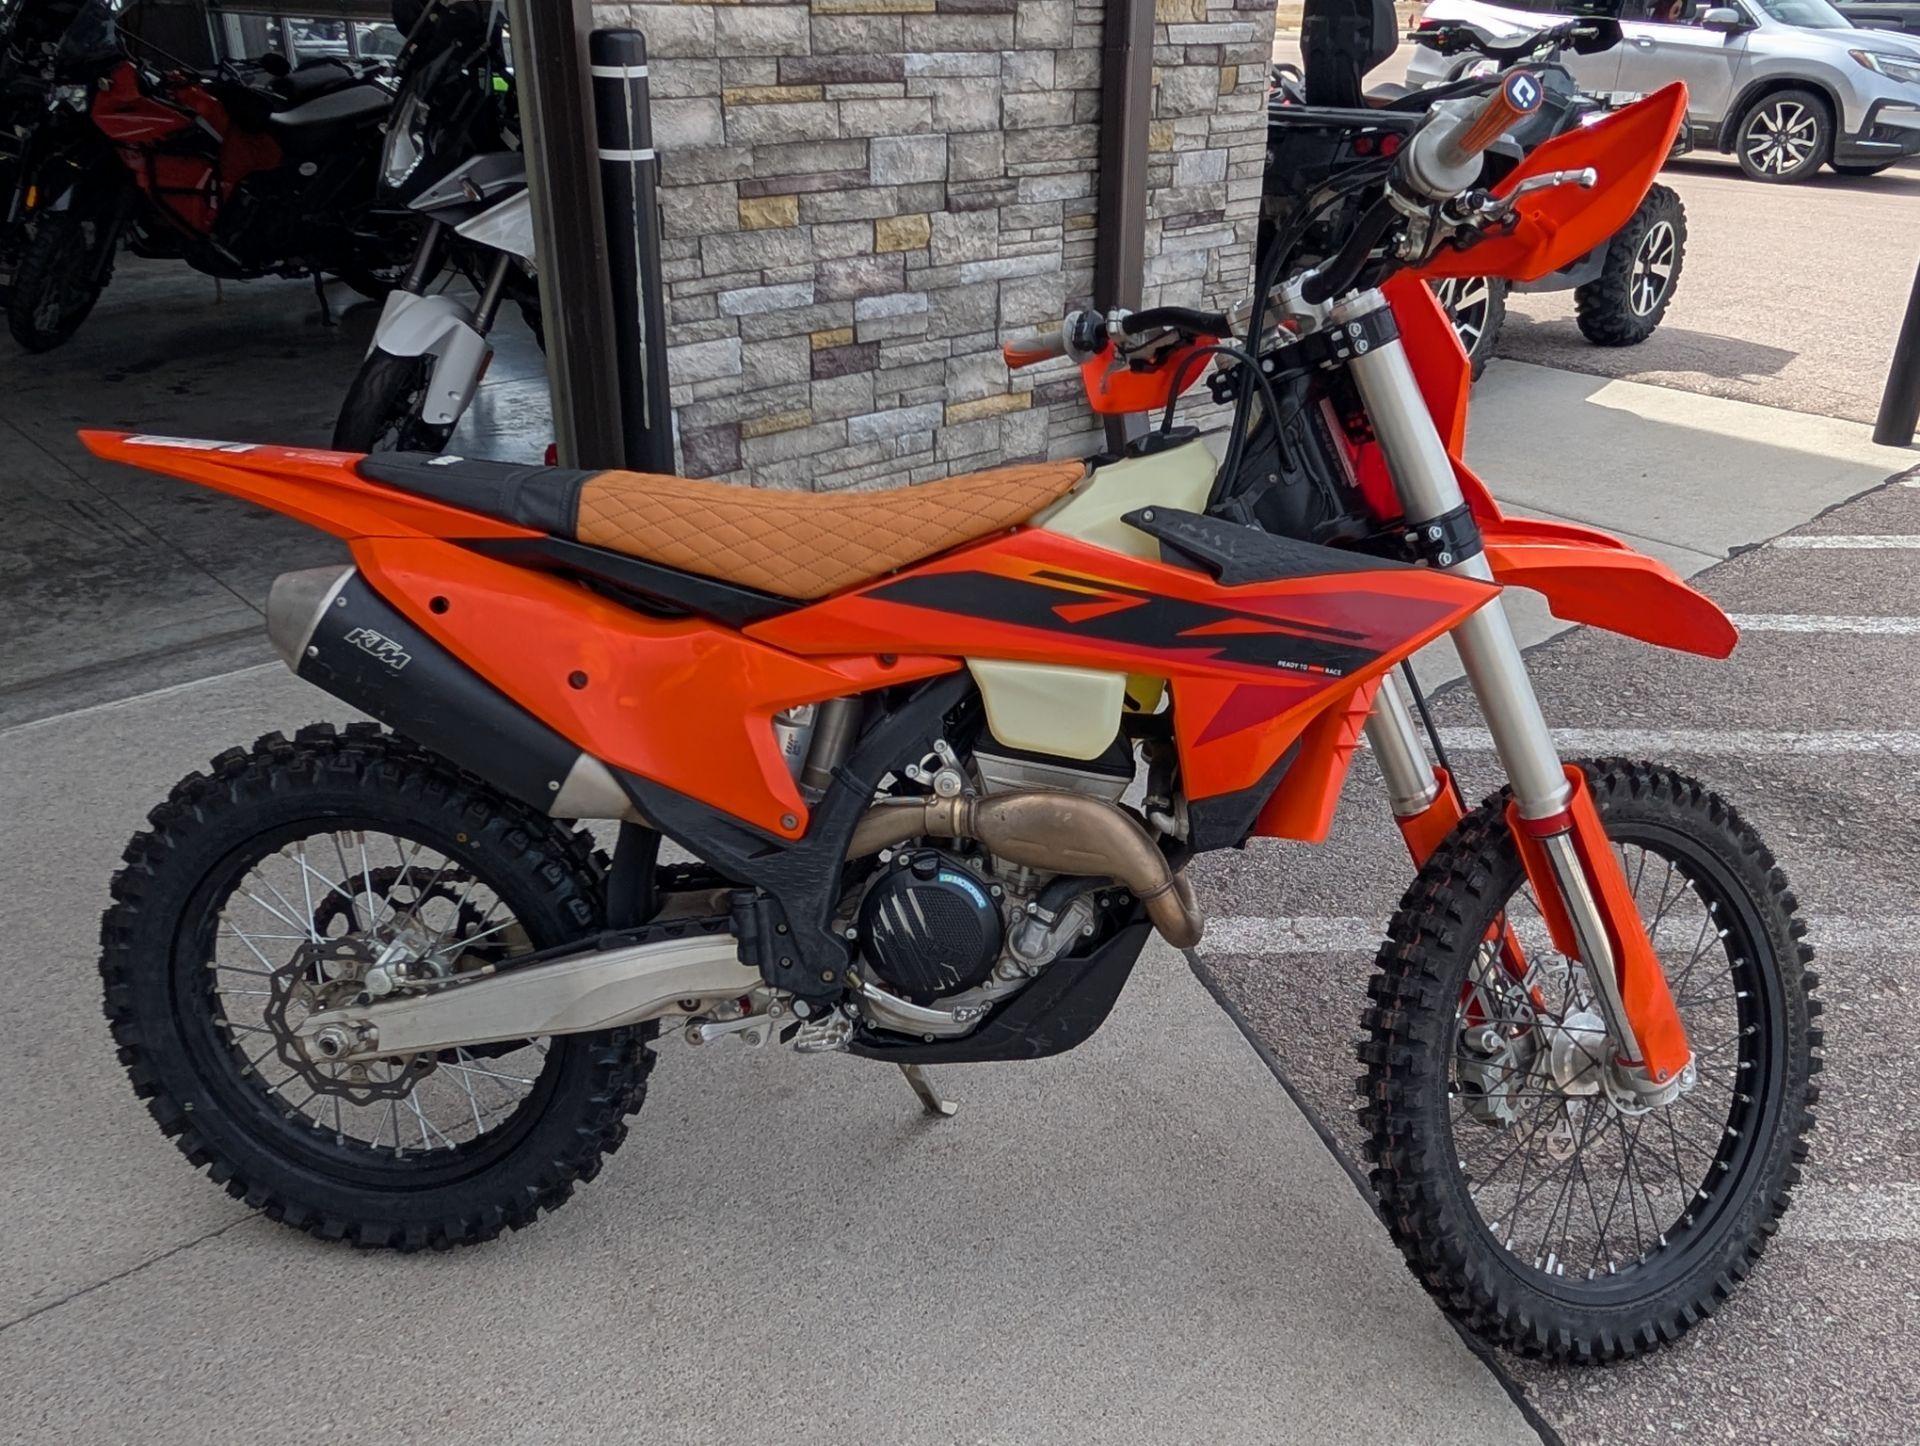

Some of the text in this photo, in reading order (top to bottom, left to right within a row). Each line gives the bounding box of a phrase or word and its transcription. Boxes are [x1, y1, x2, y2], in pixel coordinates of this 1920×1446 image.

[343, 627, 412, 670] KTM
[1277, 660, 1299, 670] READY
[1325, 668, 1342, 676] RACE
